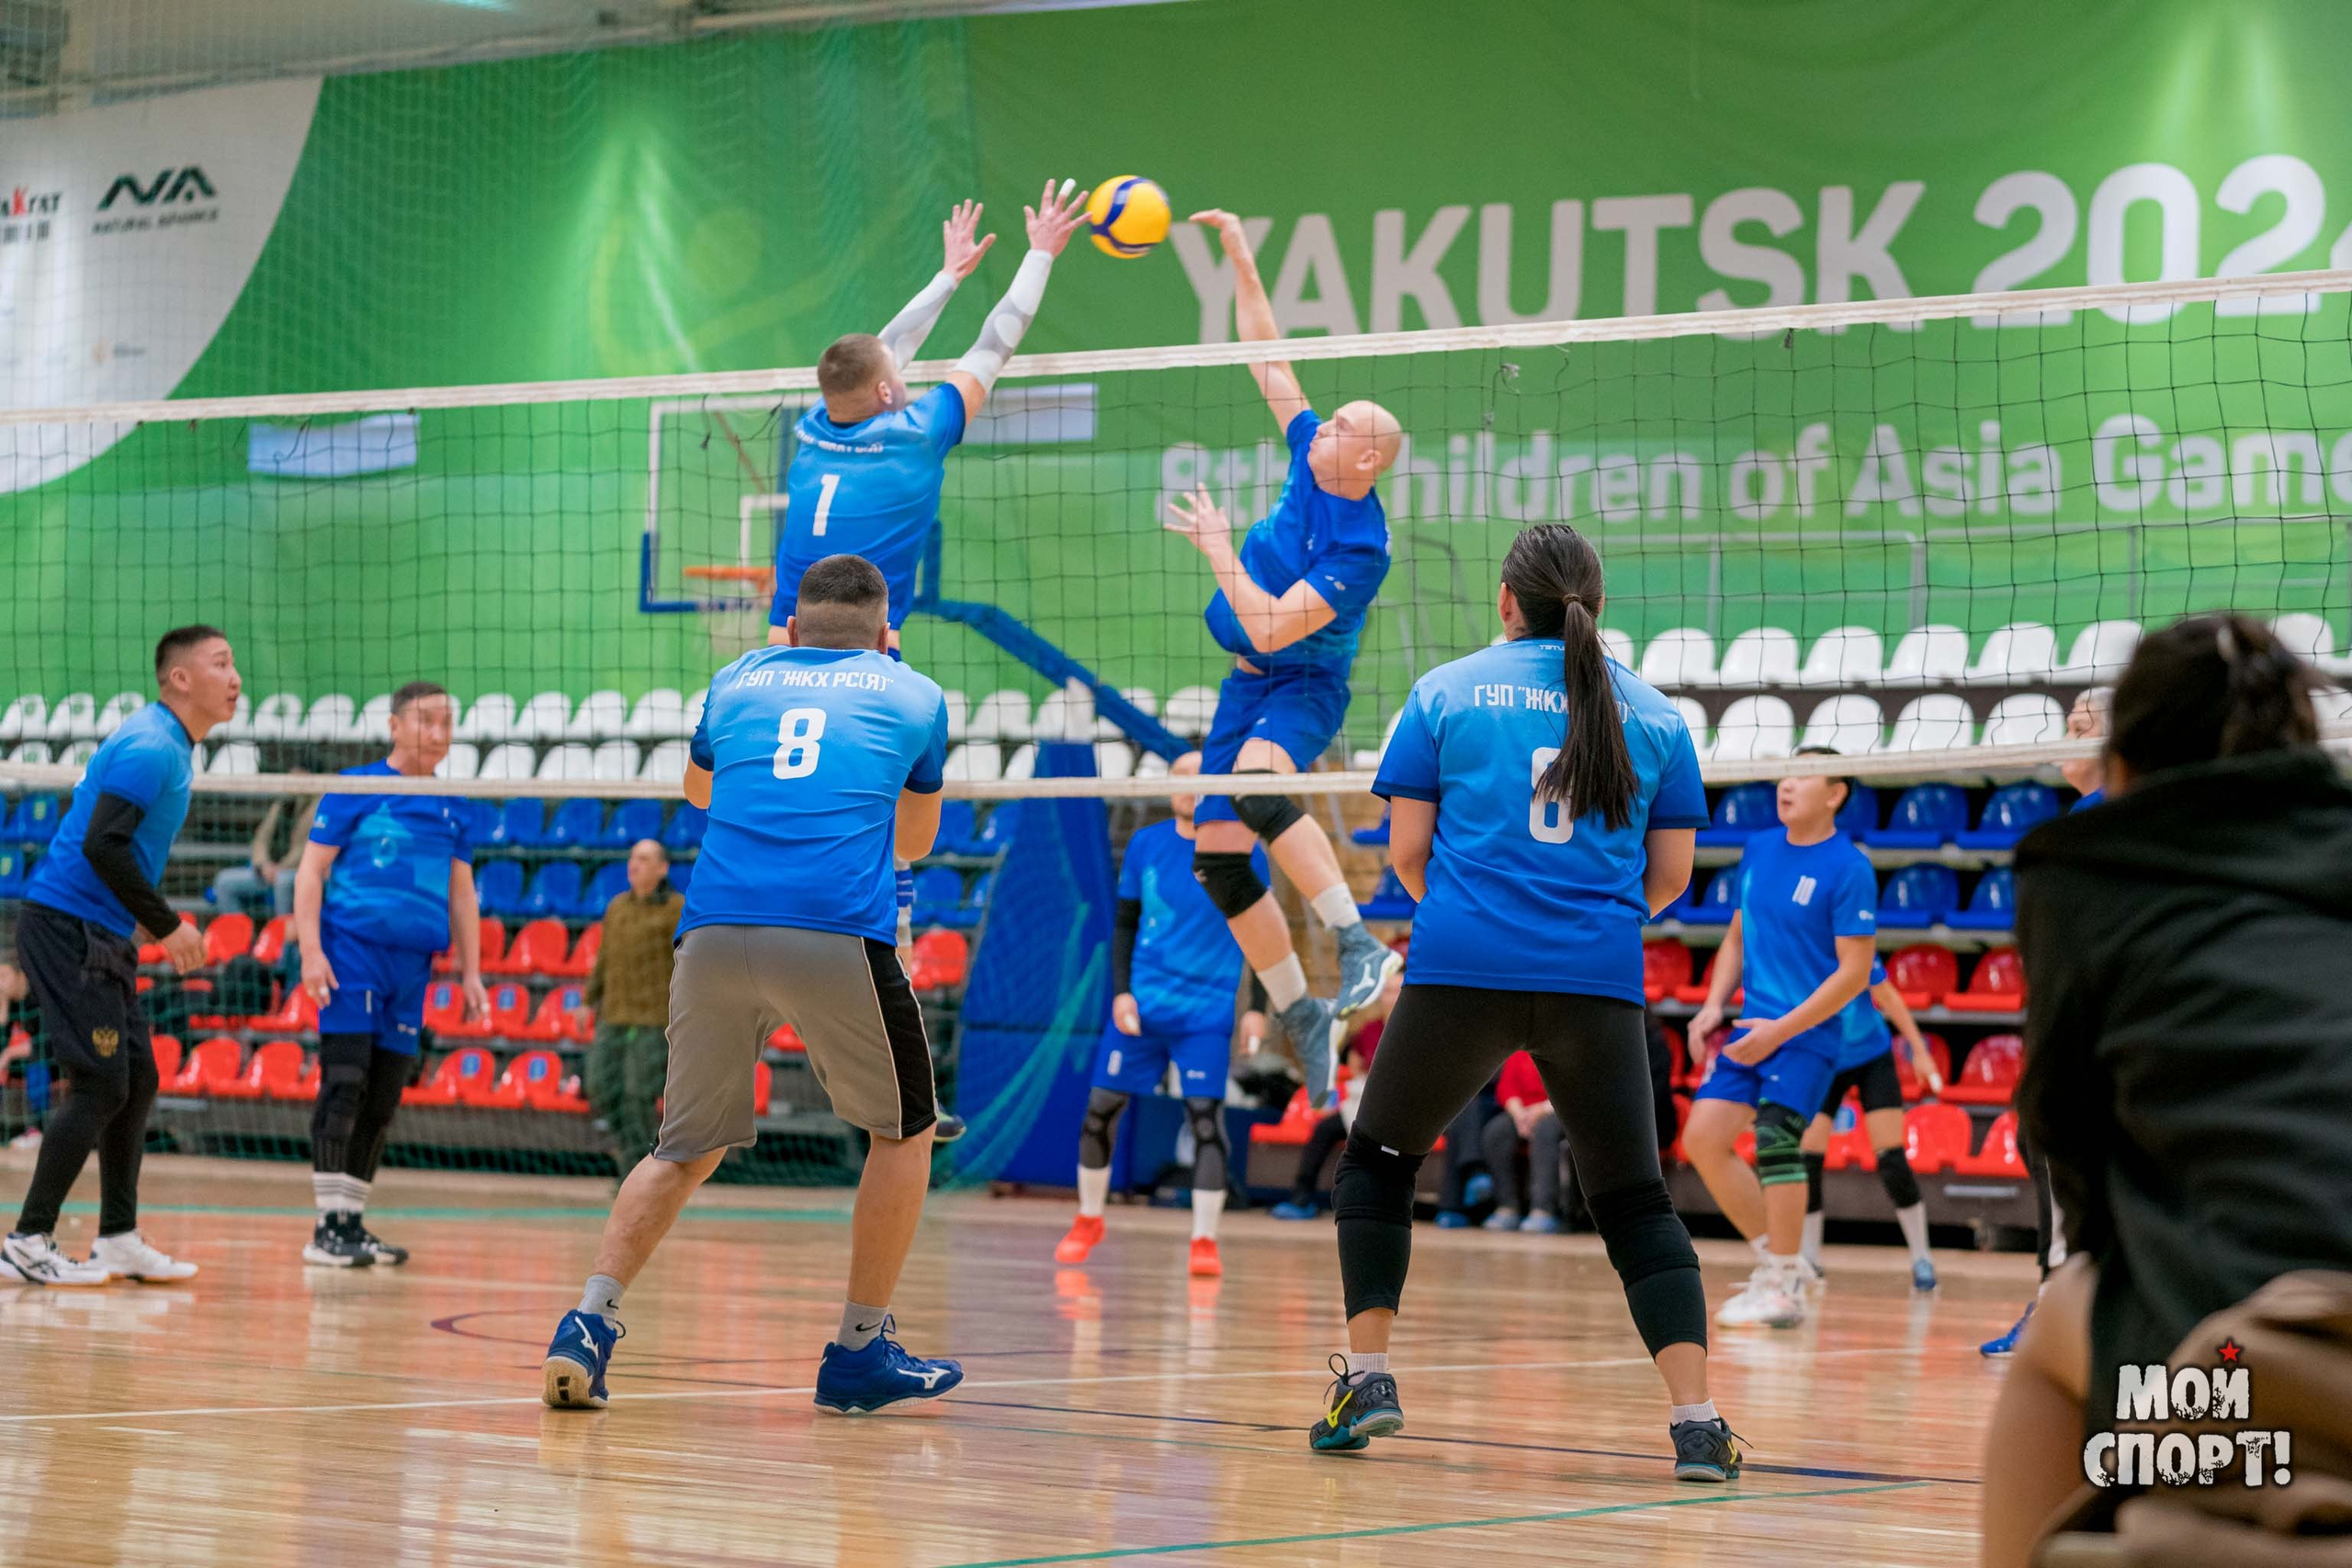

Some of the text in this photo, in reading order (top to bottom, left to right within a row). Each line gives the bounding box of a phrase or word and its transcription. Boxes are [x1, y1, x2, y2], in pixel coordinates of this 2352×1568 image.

[1171, 154, 2352, 347] YAKUTSK 202
[812, 474, 841, 536] 1
[1380, 430, 1704, 525] hildren
[1729, 422, 1831, 520] of
[1846, 419, 2062, 518] Asia
[736, 671, 775, 689] ГУП
[1474, 683, 1514, 707] ГУП
[773, 707, 827, 780] 8
